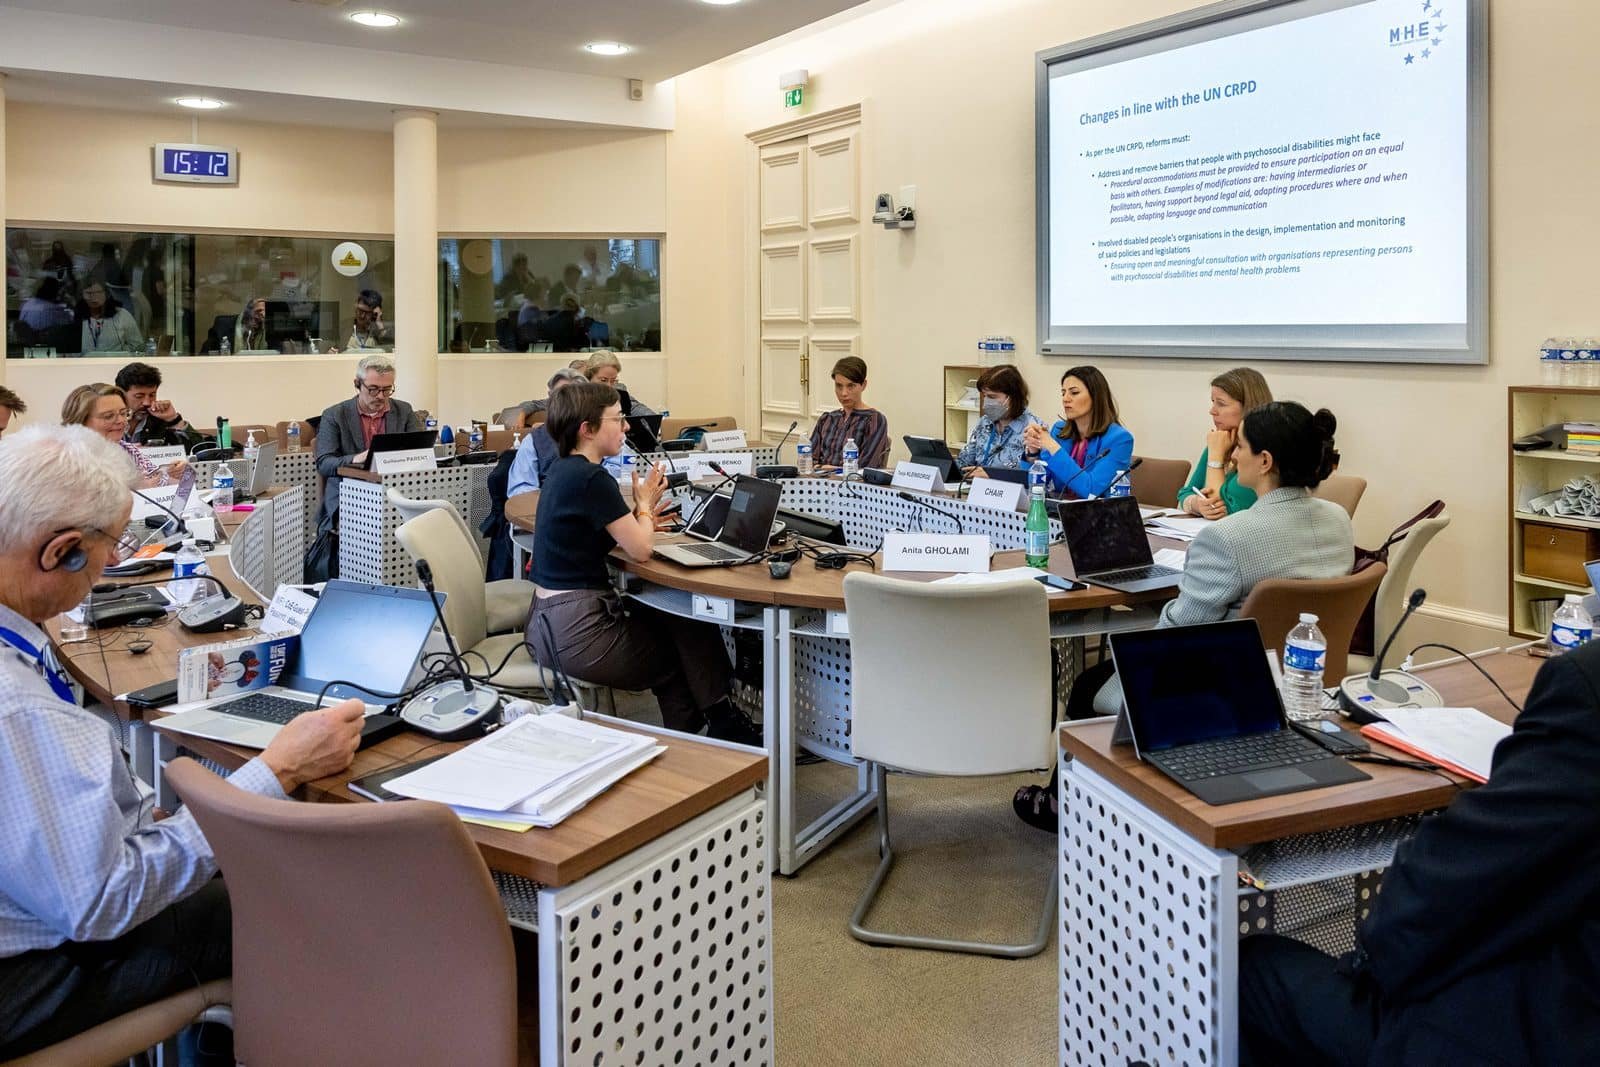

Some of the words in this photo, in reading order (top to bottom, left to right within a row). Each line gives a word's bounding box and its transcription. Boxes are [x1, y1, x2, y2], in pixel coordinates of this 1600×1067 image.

[1079, 109, 1118, 125] Changes
[1121, 105, 1130, 117] in
[1133, 103, 1152, 115] line
[1154, 95, 1178, 110] with
[1181, 92, 1200, 105] the
[1203, 86, 1220, 101] UN
[1224, 79, 1256, 97] CRPD
[1093, 149, 1103, 157] per
[1115, 144, 1125, 152] UN
[1126, 141, 1144, 151] CRPD,
[1145, 138, 1170, 147] reforms
[1171, 134, 1190, 144] must:
[1097, 169, 1120, 178] Address
[1121, 166, 1133, 175] and
[1134, 164, 1157, 173] remove
[1159, 160, 1184, 170] barriers
[1185, 157, 1199, 166] that
[1200, 153, 1224, 166] people
[1225, 151, 1242, 160] with
[1243, 143, 1290, 160] psychosocial
[1291, 138, 1334, 151] disabilities
[1335, 133, 1360, 146] might
[1362, 131, 1380, 141] face
[1198, 167, 1216, 176] must
[1217, 166, 1226, 174] be
[1227, 160, 1259, 175] provided
[1270, 158, 1296, 167] ensure
[1297, 150, 1350, 166] participation
[1351, 149, 1363, 157] on
[1364, 147, 1376, 155] an
[1378, 141, 1404, 154] equal
[1110, 191, 1125, 200] basis
[1126, 189, 1139, 198] with
[1163, 183, 1194, 193] Examples
[1195, 180, 1203, 191] of
[1203, 176, 1251, 189] modifications
[1252, 175, 1267, 183] are:
[1269, 170, 1295, 181] having
[1296, 163, 1355, 177] intermediaries
[1357, 162, 1367, 170] or
[1144, 199, 1166, 208] having
[1167, 196, 1192, 206] support
[1193, 191, 1219, 203] beyond
[1219, 189, 1237, 201] legal
[1238, 188, 1252, 198] aid,
[1253, 185, 1287, 196] adapting
[1288, 180, 1333, 194] procedures
[1335, 177, 1361, 187] where
[1363, 173, 1381, 184] and
[1383, 172, 1407, 182] when
[1110, 214, 1135, 224] possible,
[1136, 211, 1164, 220] adapting
[1165, 208, 1196, 218] language
[1197, 205, 1211, 214] and
[1212, 200, 1267, 213] communication
[1123, 235, 1148, 245] disabled
[1149, 233, 1176, 244] people's
[1177, 231, 1222, 242] organisations
[1223, 229, 1230, 237] in
[1231, 228, 1244, 237] the
[1245, 226, 1271, 236] design,
[1273, 221, 1336, 235] implementation
[1338, 218, 1354, 228] and
[1356, 215, 1405, 227] monitoring
[1097, 250, 1104, 259] of
[1105, 250, 1117, 258] said
[1118, 249, 1140, 258] policies
[1141, 247, 1153, 256] and
[1154, 246, 1190, 256] legislations
[1153, 258, 1166, 267] and
[1166, 256, 1204, 266] meaningful
[1205, 255, 1248, 264] consultation
[1250, 252, 1266, 261] with
[1268, 250, 1320, 262] organisations
[1322, 247, 1375, 259] representing
[1377, 245, 1412, 256] persons
[1124, 271, 1163, 282] psychosocial
[1163, 270, 1197, 278] disabilities
[1199, 268, 1213, 277] and
[1213, 266, 1239, 276] mental
[1239, 265, 1263, 275] health
[1264, 264, 1300, 276] problems
[984, 488, 1004, 498] CHAIR
[924, 546, 969, 555] GHOLAMI
